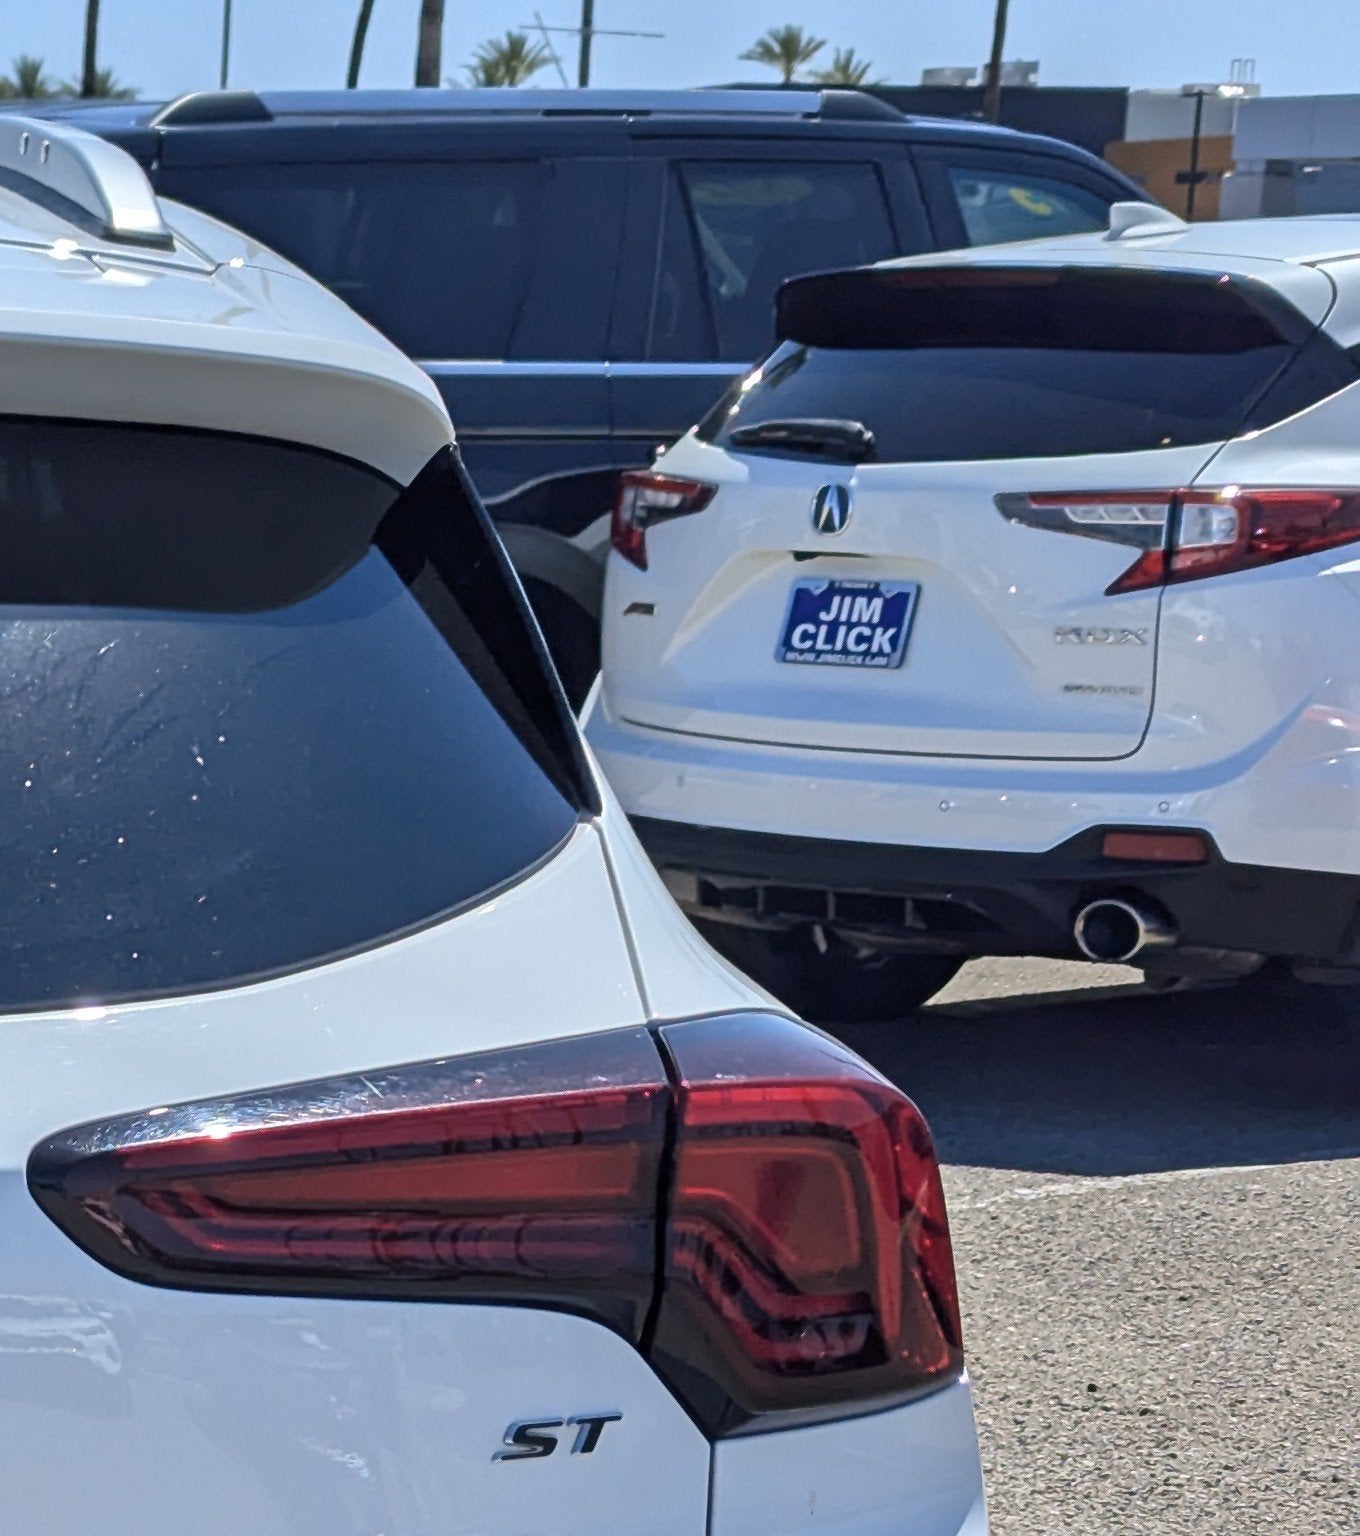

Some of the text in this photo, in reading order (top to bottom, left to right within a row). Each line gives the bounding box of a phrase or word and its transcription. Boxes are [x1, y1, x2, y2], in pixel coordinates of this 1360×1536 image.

[818, 594, 884, 624] JIM
[790, 622, 898, 654] CLICK
[490, 1411, 624, 1465] ST
